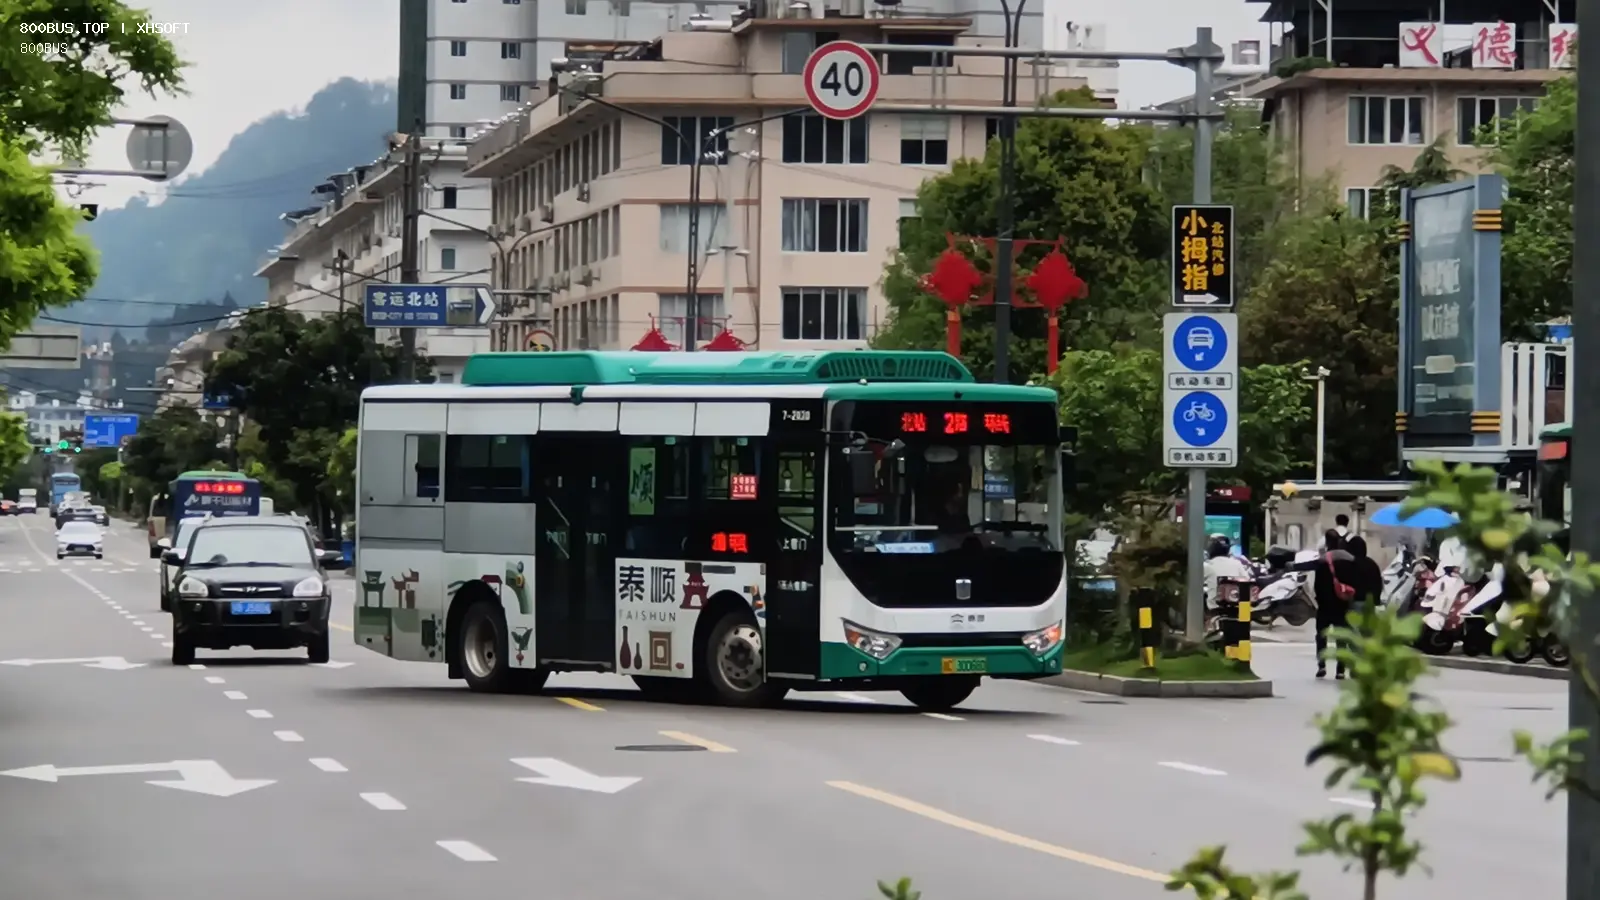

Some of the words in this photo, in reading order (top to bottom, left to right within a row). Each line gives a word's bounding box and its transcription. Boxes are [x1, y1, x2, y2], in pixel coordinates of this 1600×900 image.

[820, 61, 864, 96] 40
[1181, 209, 1209, 290] 小拇指
[372, 291, 439, 307] 客运北站
[1175, 376, 1225, 387] 机动车道
[1173, 452, 1227, 462] 非机动车道
[618, 564, 676, 603] 泰顺
[618, 609, 676, 622] TAISHUN
